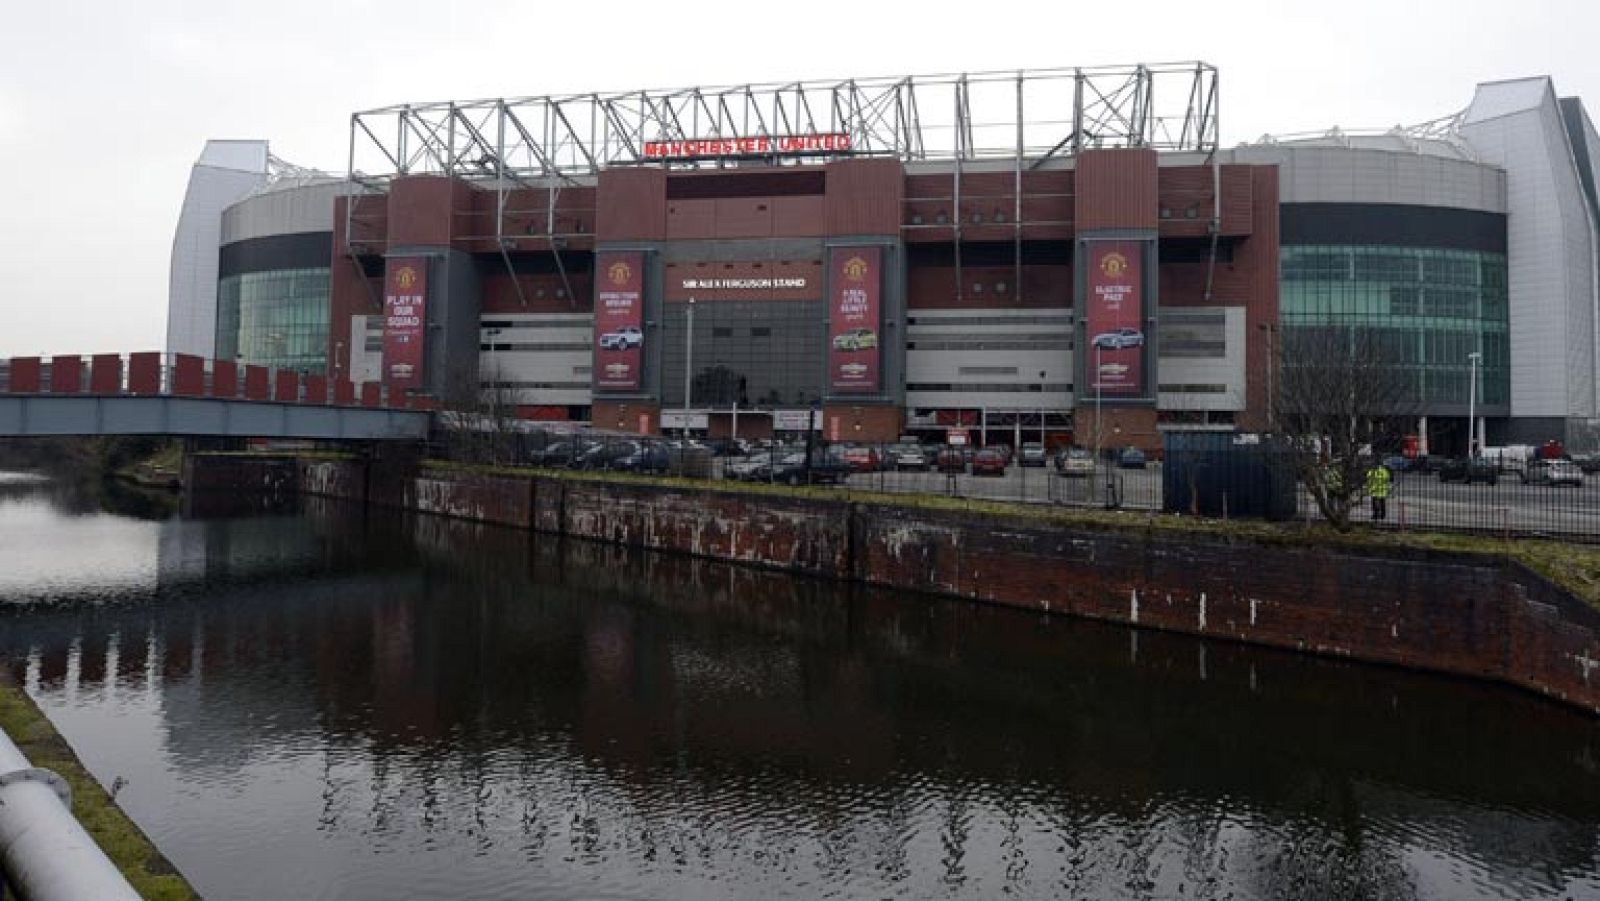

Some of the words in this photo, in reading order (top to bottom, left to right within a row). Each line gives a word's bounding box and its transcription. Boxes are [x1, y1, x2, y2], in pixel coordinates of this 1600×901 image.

[645, 136, 770, 156] MANCHESTER
[778, 133, 850, 151] UNITED
[682, 279, 697, 289] SIR
[699, 279, 720, 289] ALEX
[722, 279, 772, 289] FERGUSON
[774, 278, 805, 289] STAND
[386, 295, 411, 305] PLAY
[394, 305, 414, 316] OUR
[387, 316, 420, 327] SQUAD
